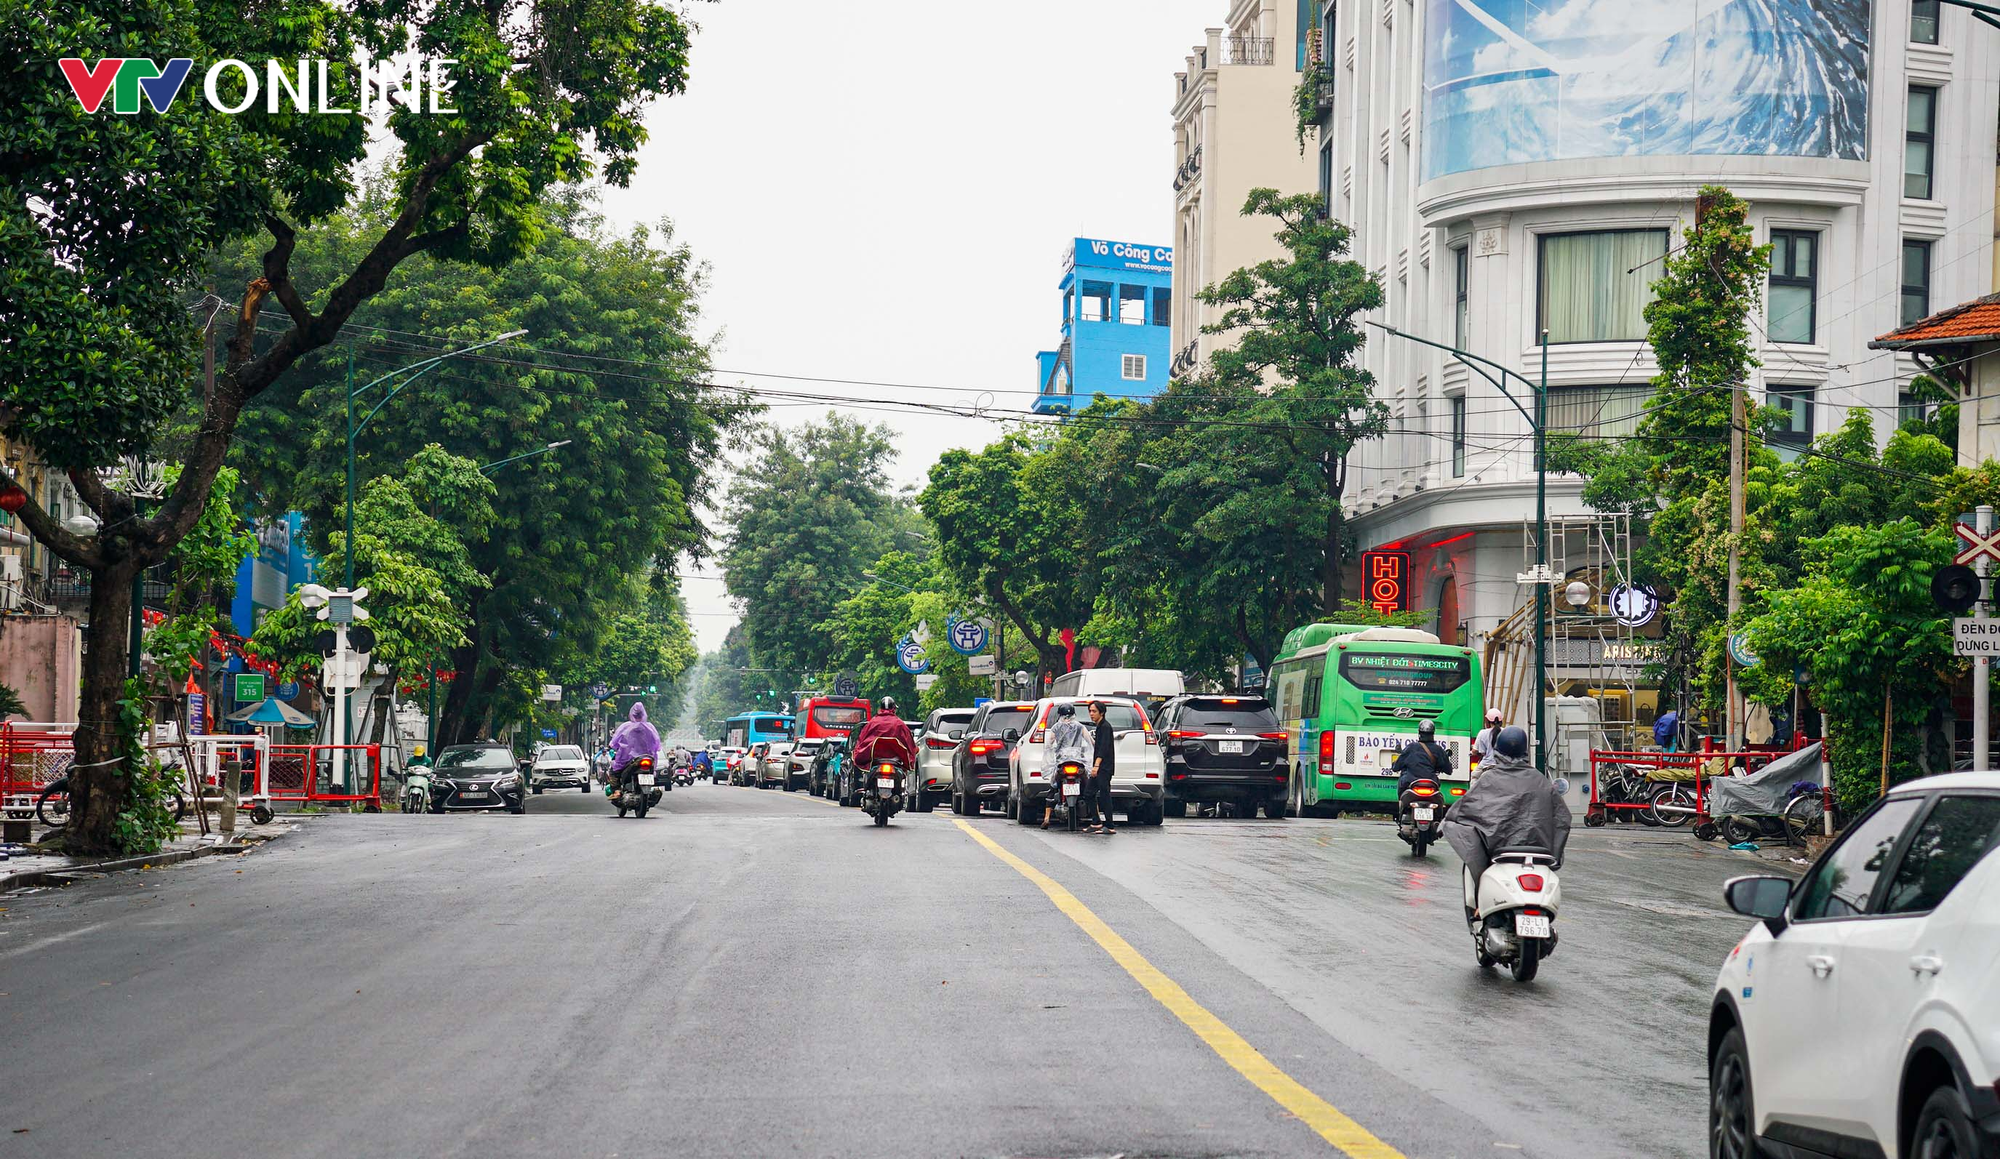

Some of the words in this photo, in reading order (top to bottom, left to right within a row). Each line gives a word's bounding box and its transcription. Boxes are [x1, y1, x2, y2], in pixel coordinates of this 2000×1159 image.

[1091, 240, 1109, 256] Võ
[1113, 243, 1150, 263] Công
[1372, 556, 1399, 618] HOT
[1961, 620, 1986, 635] ĐÈN
[1989, 624, 2000, 635] Đ
[1957, 637, 1990, 651] DỪNG
[242, 688, 257, 696] 315
[1359, 732, 1379, 748] BẢO
[1382, 733, 1402, 748] YẾN
[1522, 917, 1544, 927] 29-L1
[1520, 926, 1547, 935] 796.70
